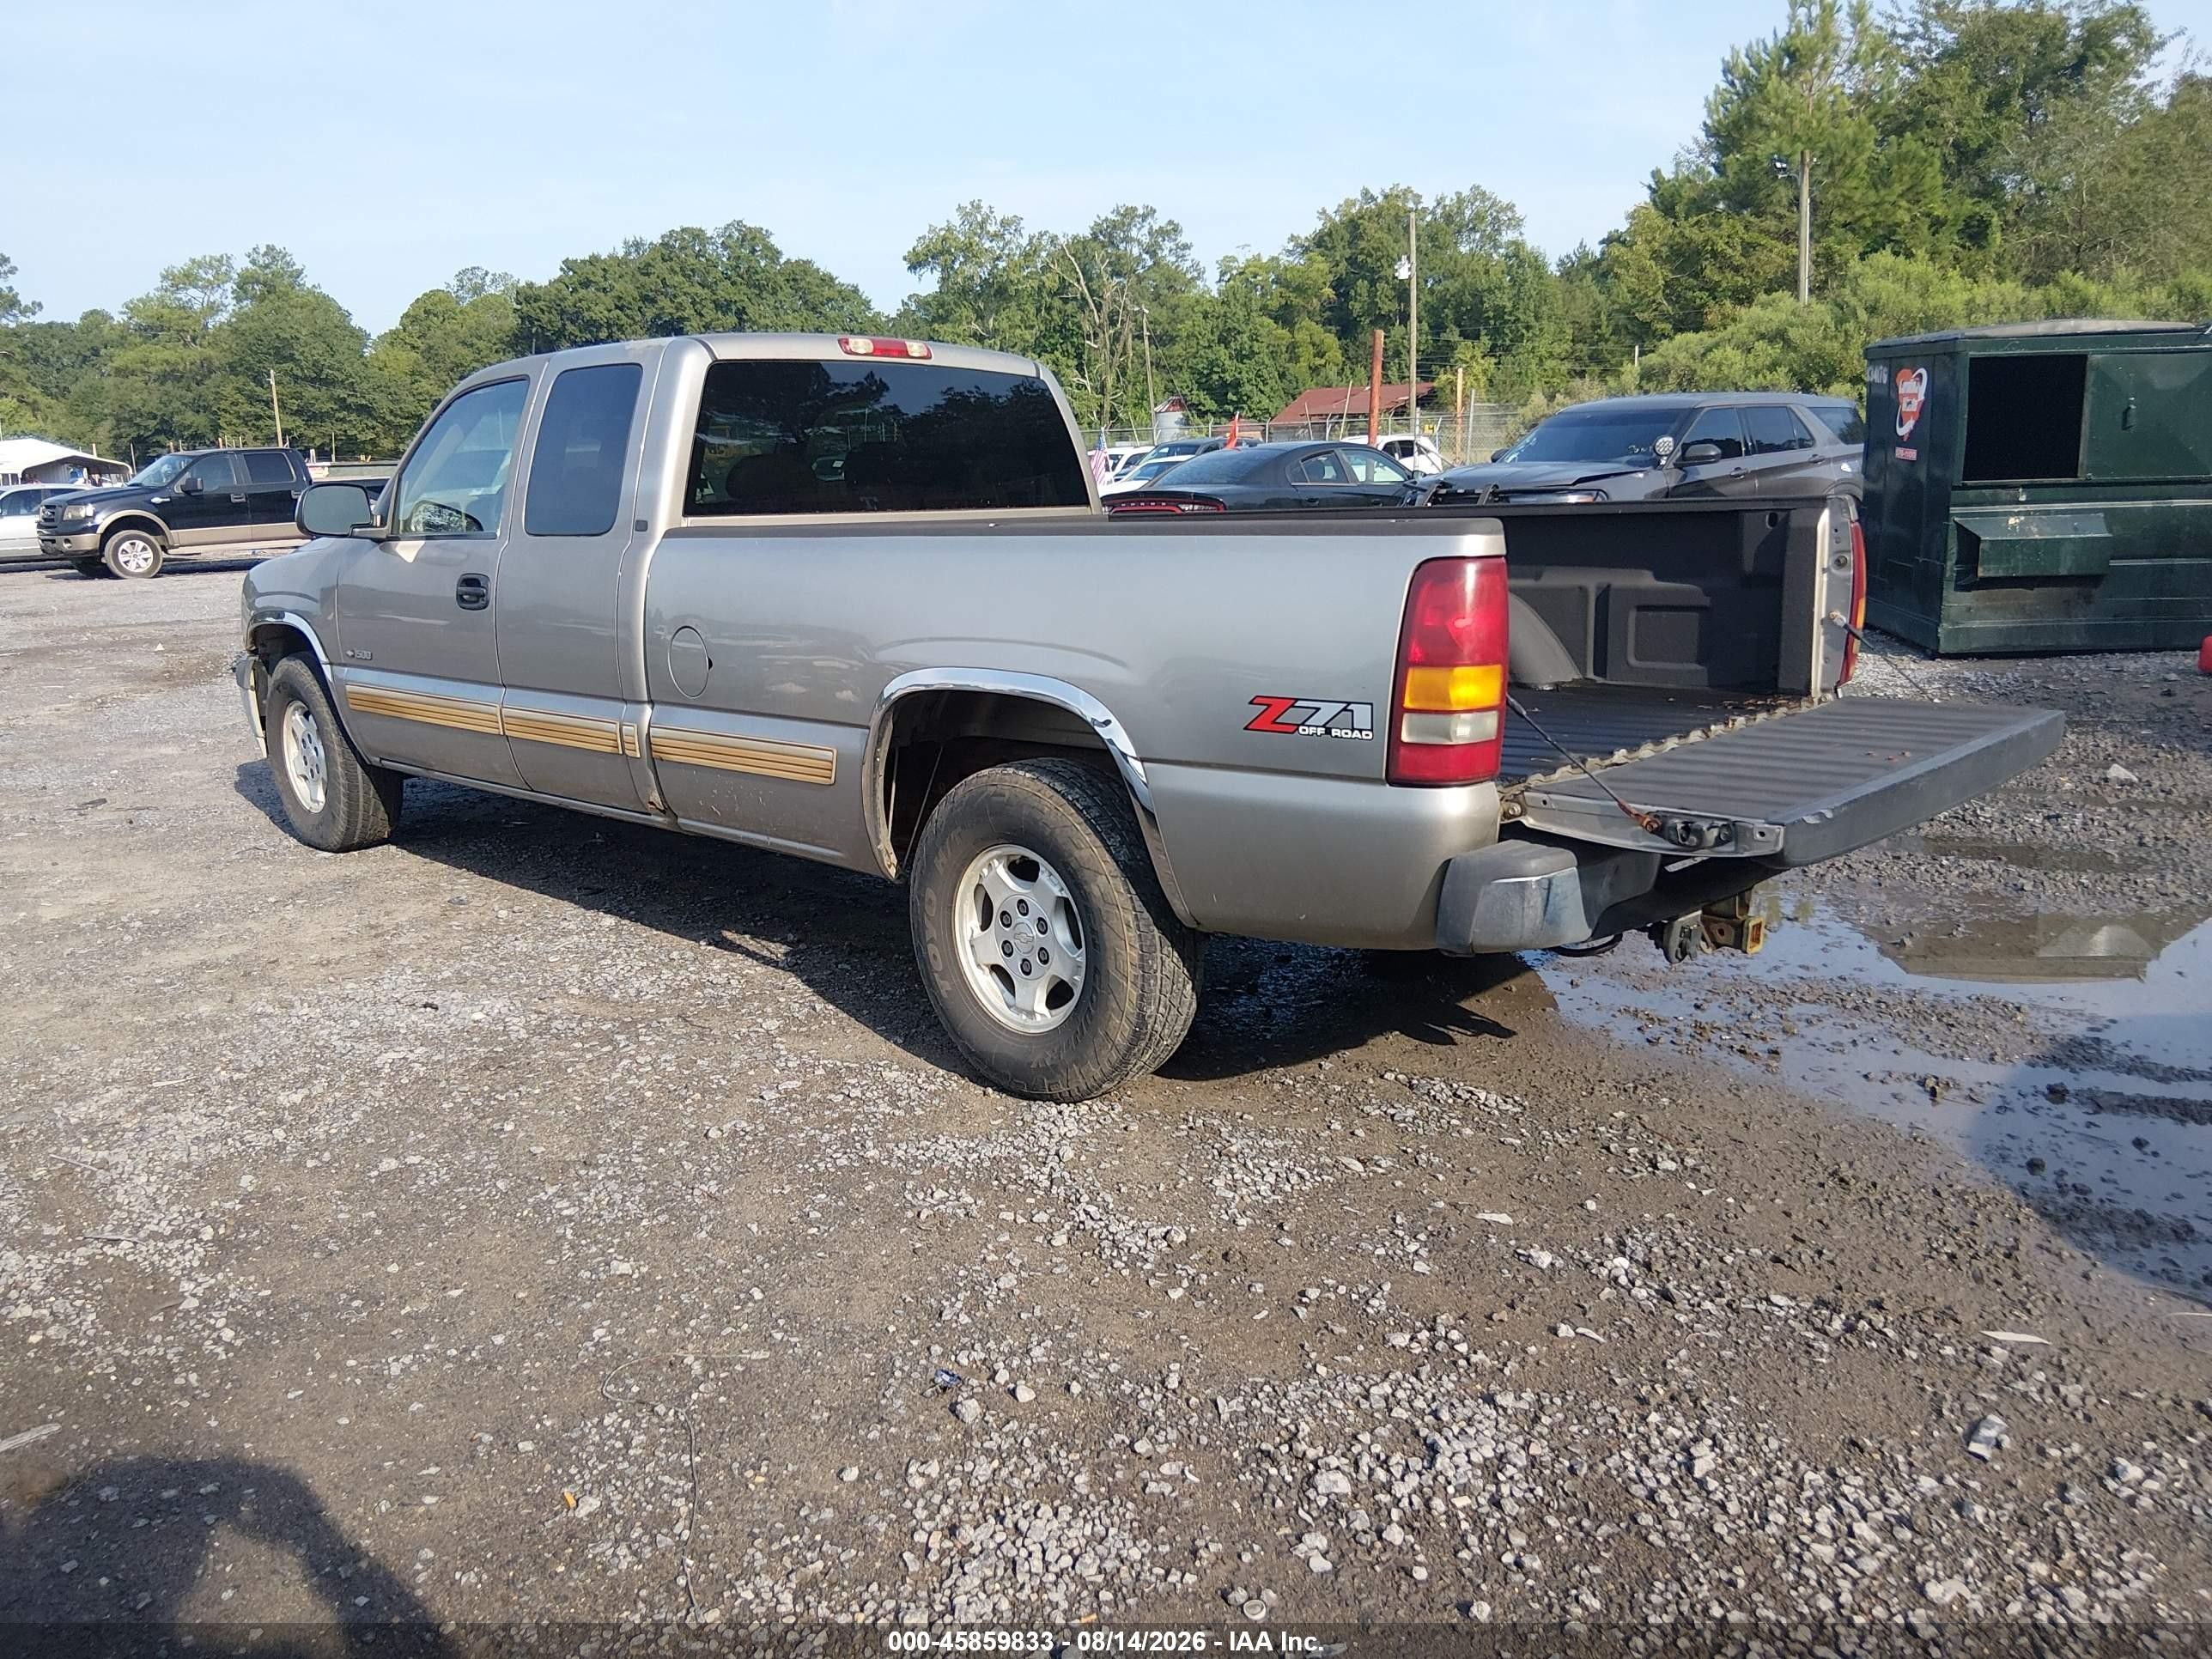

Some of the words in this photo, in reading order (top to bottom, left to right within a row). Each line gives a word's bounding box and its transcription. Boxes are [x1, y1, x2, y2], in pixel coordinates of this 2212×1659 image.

[1243, 696, 1374, 734] Z71
[1297, 725, 1327, 737] OFF
[1330, 728, 1374, 742] ROAD
[924, 886, 951, 998] TOYO
